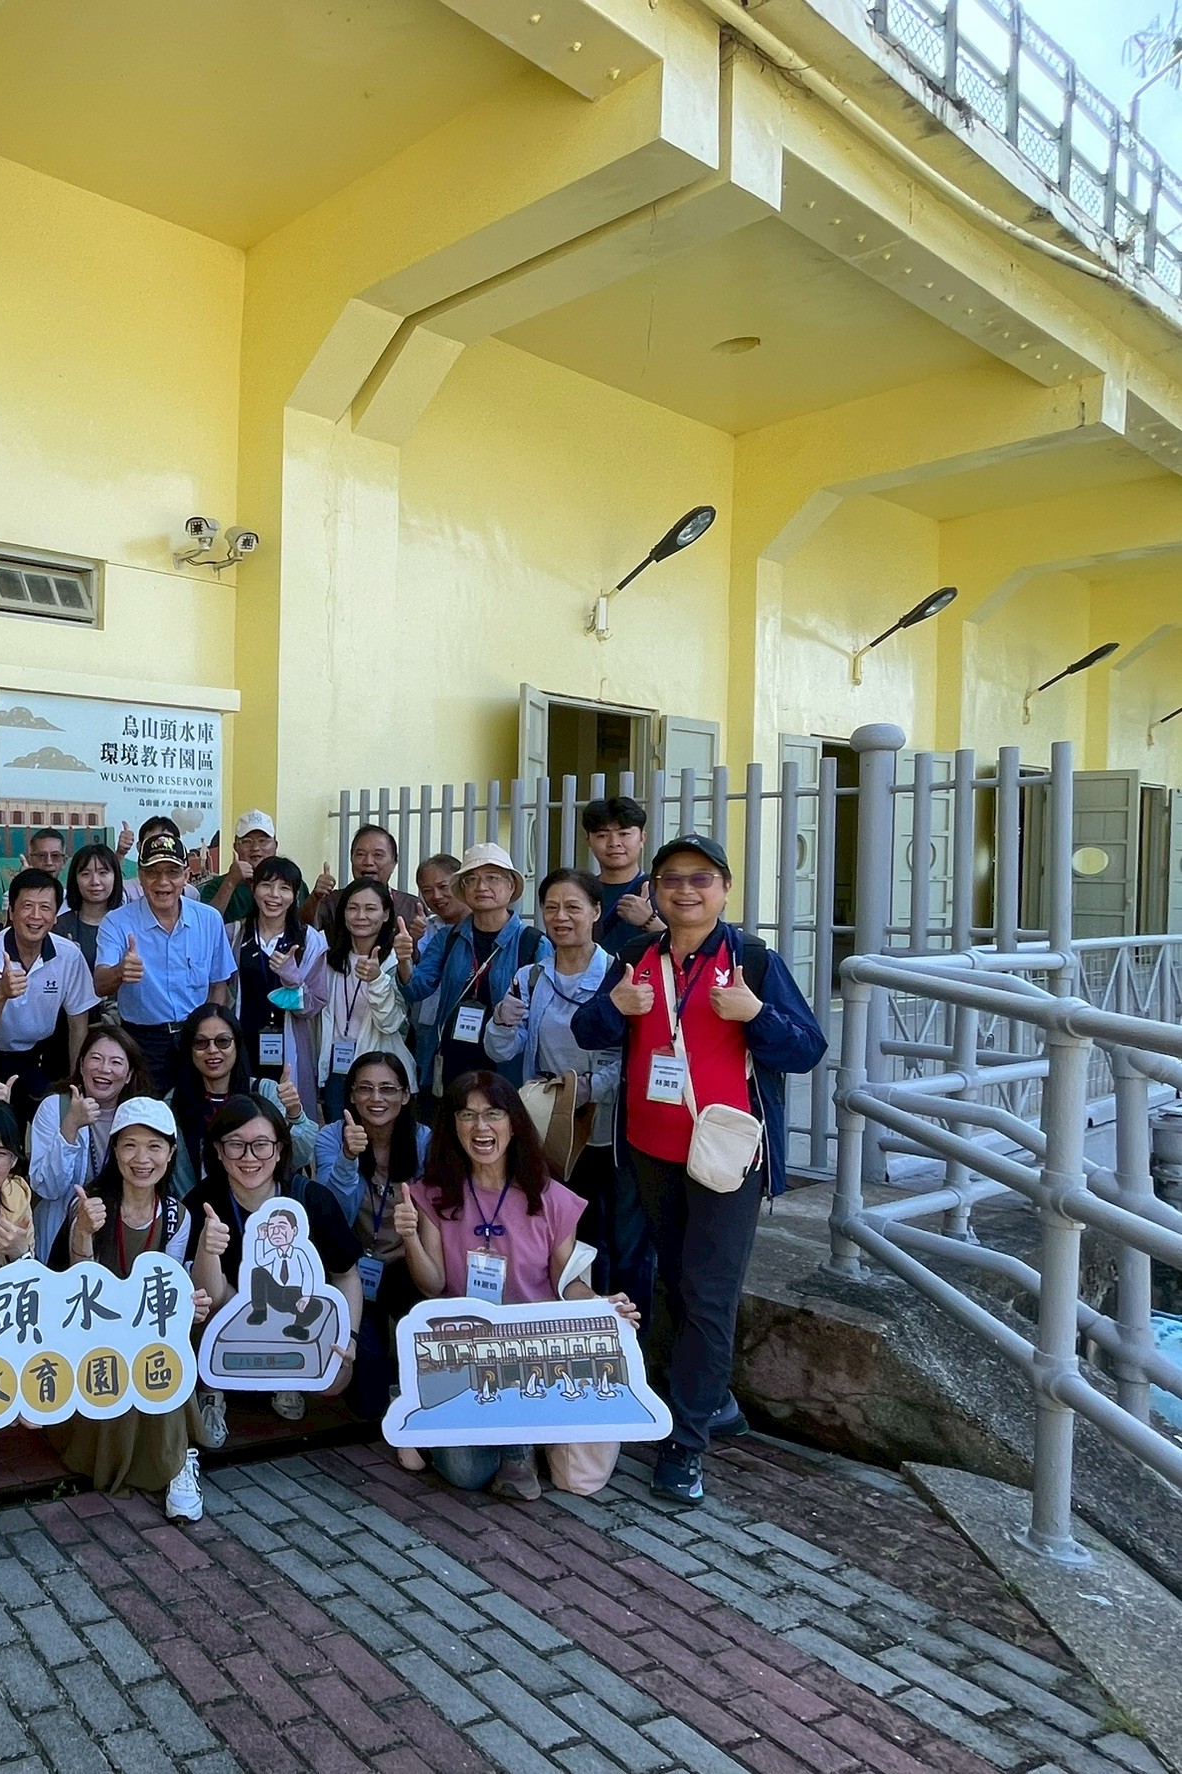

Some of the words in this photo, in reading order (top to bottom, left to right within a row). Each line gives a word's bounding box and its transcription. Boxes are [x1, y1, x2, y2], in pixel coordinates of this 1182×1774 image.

[122, 715, 214, 744] 烏山頭水庫
[100, 742, 214, 771] 環境教育園區
[100, 772, 154, 785] WUSANTO
[158, 775, 214, 788] RESERVOIR
[123, 786, 167, 795] Environmental
[169, 788, 197, 797] Education
[198, 790, 213, 798] Field
